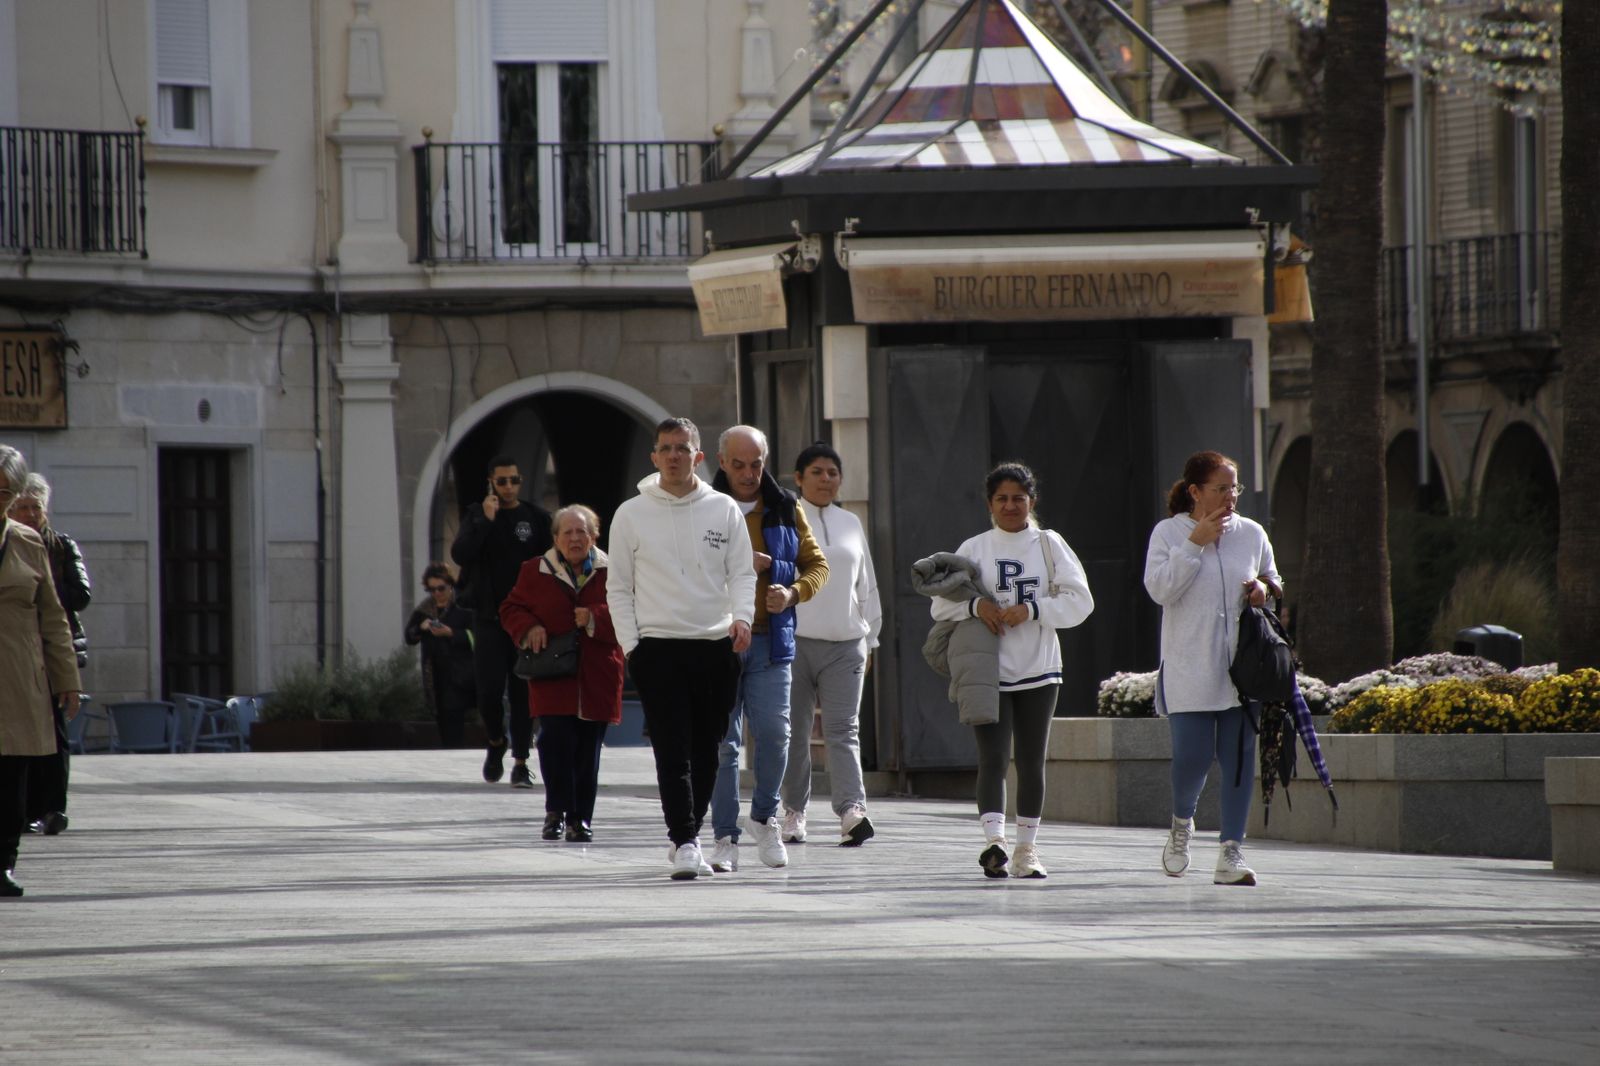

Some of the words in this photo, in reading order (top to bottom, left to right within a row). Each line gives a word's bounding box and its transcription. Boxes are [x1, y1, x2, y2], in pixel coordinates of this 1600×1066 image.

[934, 274, 1040, 311] BURGUER
[1047, 271, 1172, 309] FERNANDO
[0, 340, 42, 398] ESA
